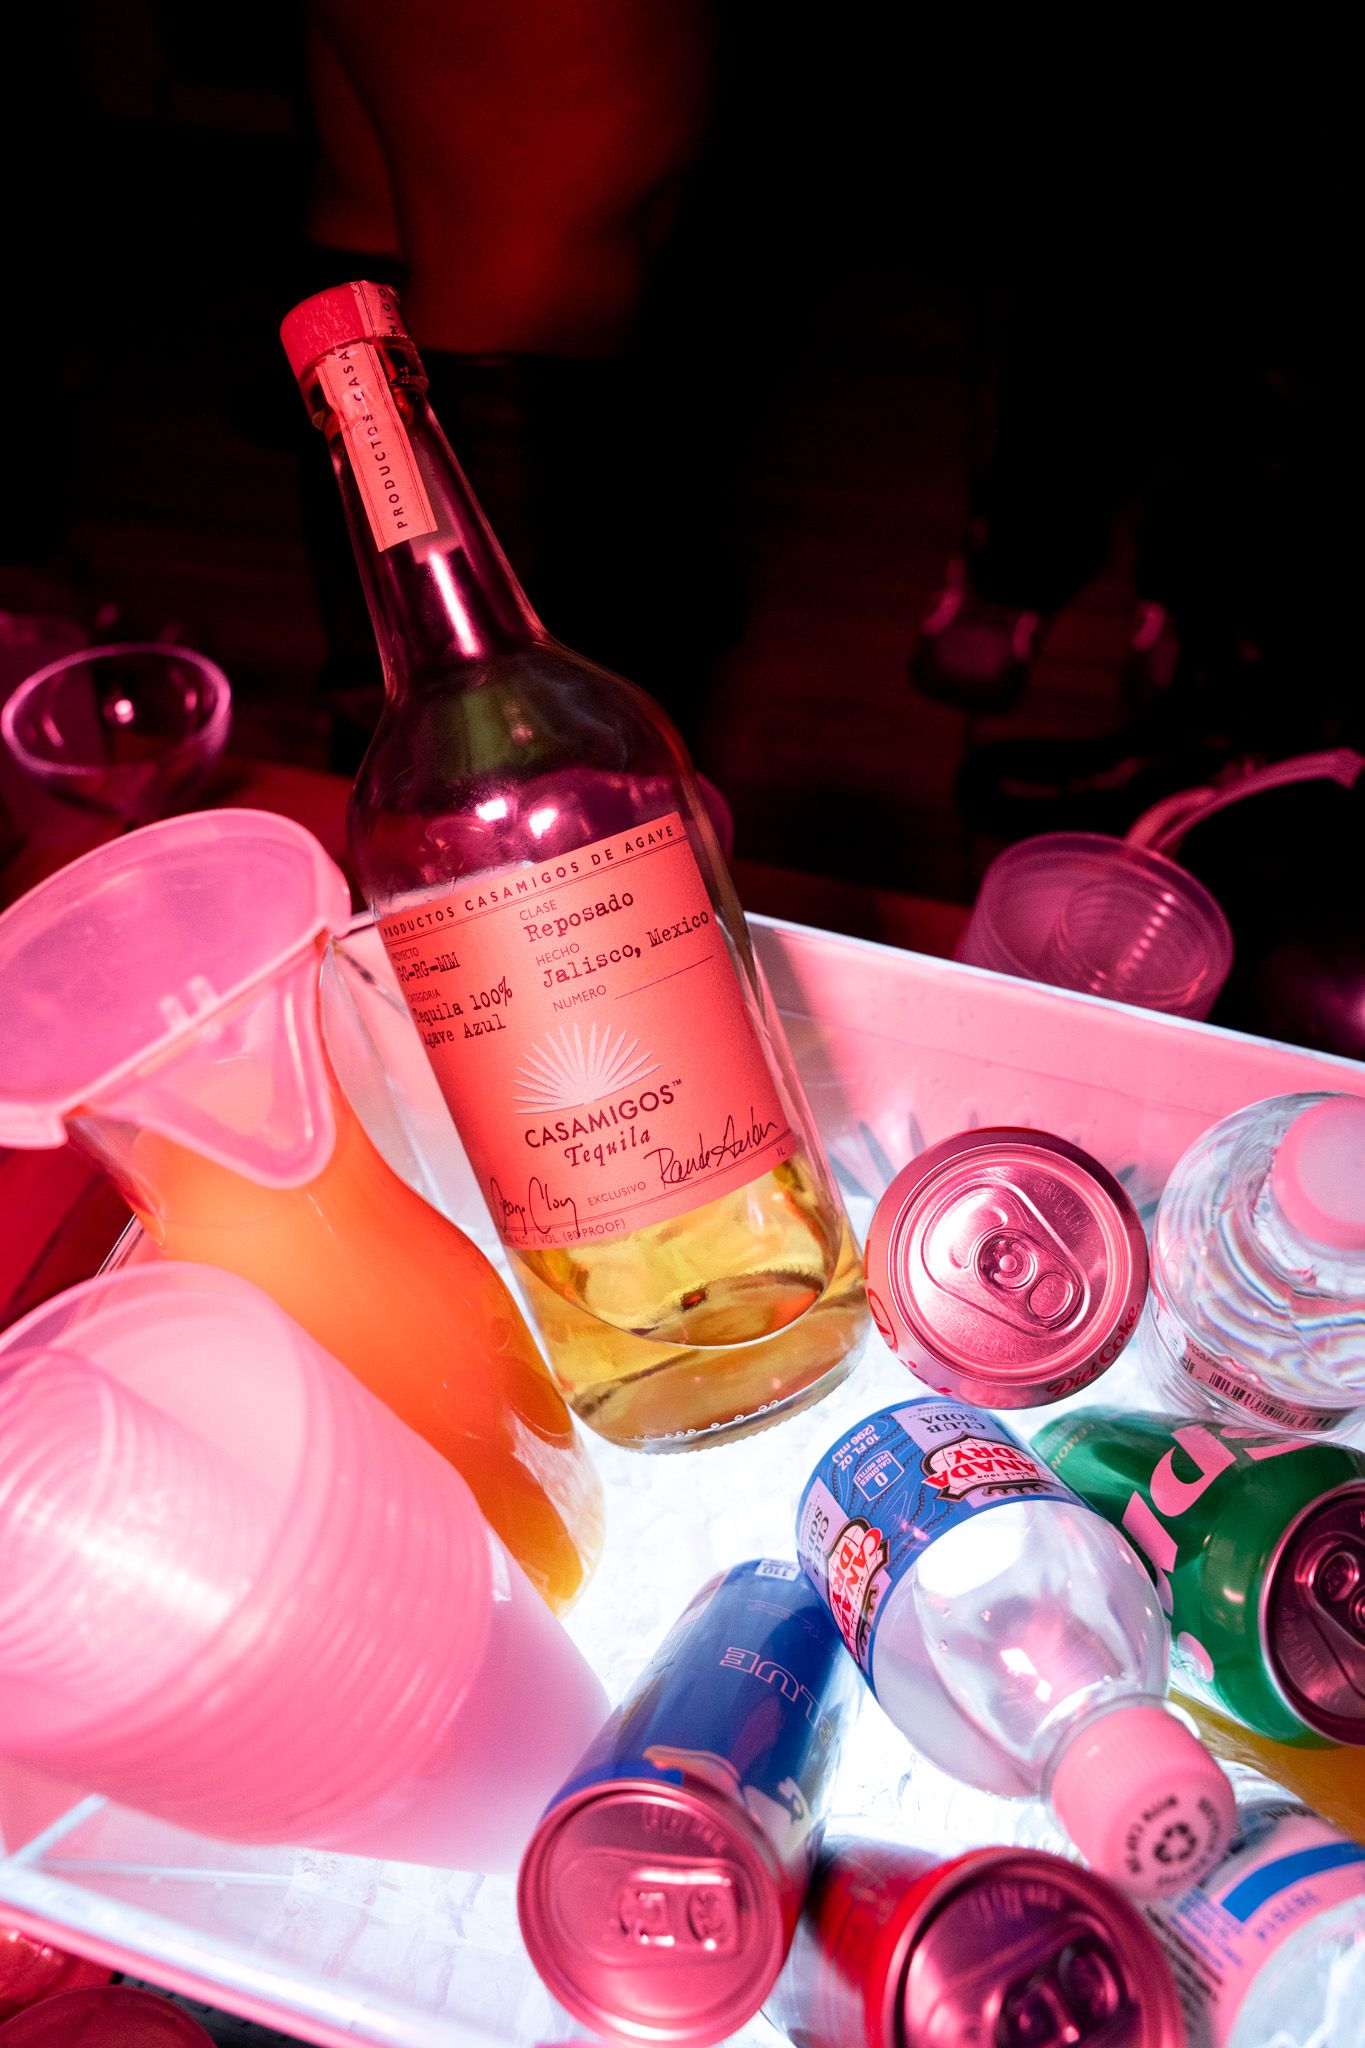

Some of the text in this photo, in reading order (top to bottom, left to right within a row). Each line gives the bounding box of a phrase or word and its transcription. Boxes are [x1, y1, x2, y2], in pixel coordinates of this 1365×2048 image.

[362, 414, 408, 529] PRODUCTOS
[384, 825, 674, 938] PRODUCTOS CASAMIGOS DE AGAVE
[519, 899, 558, 921] CLASE
[523, 892, 634, 942] Reposado
[535, 943, 580, 967] HECHO
[543, 911, 709, 988] Jalisco, Mexico
[470, 976, 513, 1011] 100%
[552, 985, 607, 1012] NUMERO
[463, 1014, 507, 1039] Azul
[564, 1127, 651, 1168] Tequila
[587, 1181, 646, 1207] EXCLUSIVO
[581, 1217, 626, 1239] PROOF)
[1046, 1368, 1098, 1397] Diet
[919, 1412, 978, 1424] SODA
[926, 1422, 986, 1434] CLUB
[831, 1424, 875, 1463] (296 mL)
[838, 1433, 880, 1471] 10 FL OZ
[856, 1453, 889, 1482] PER BOTTLE
[860, 1457, 892, 1487] CALORIES
[874, 1471, 889, 1487] 0
[923, 1460, 1036, 1488] ANADA
[841, 1528, 883, 1655] CANAD
